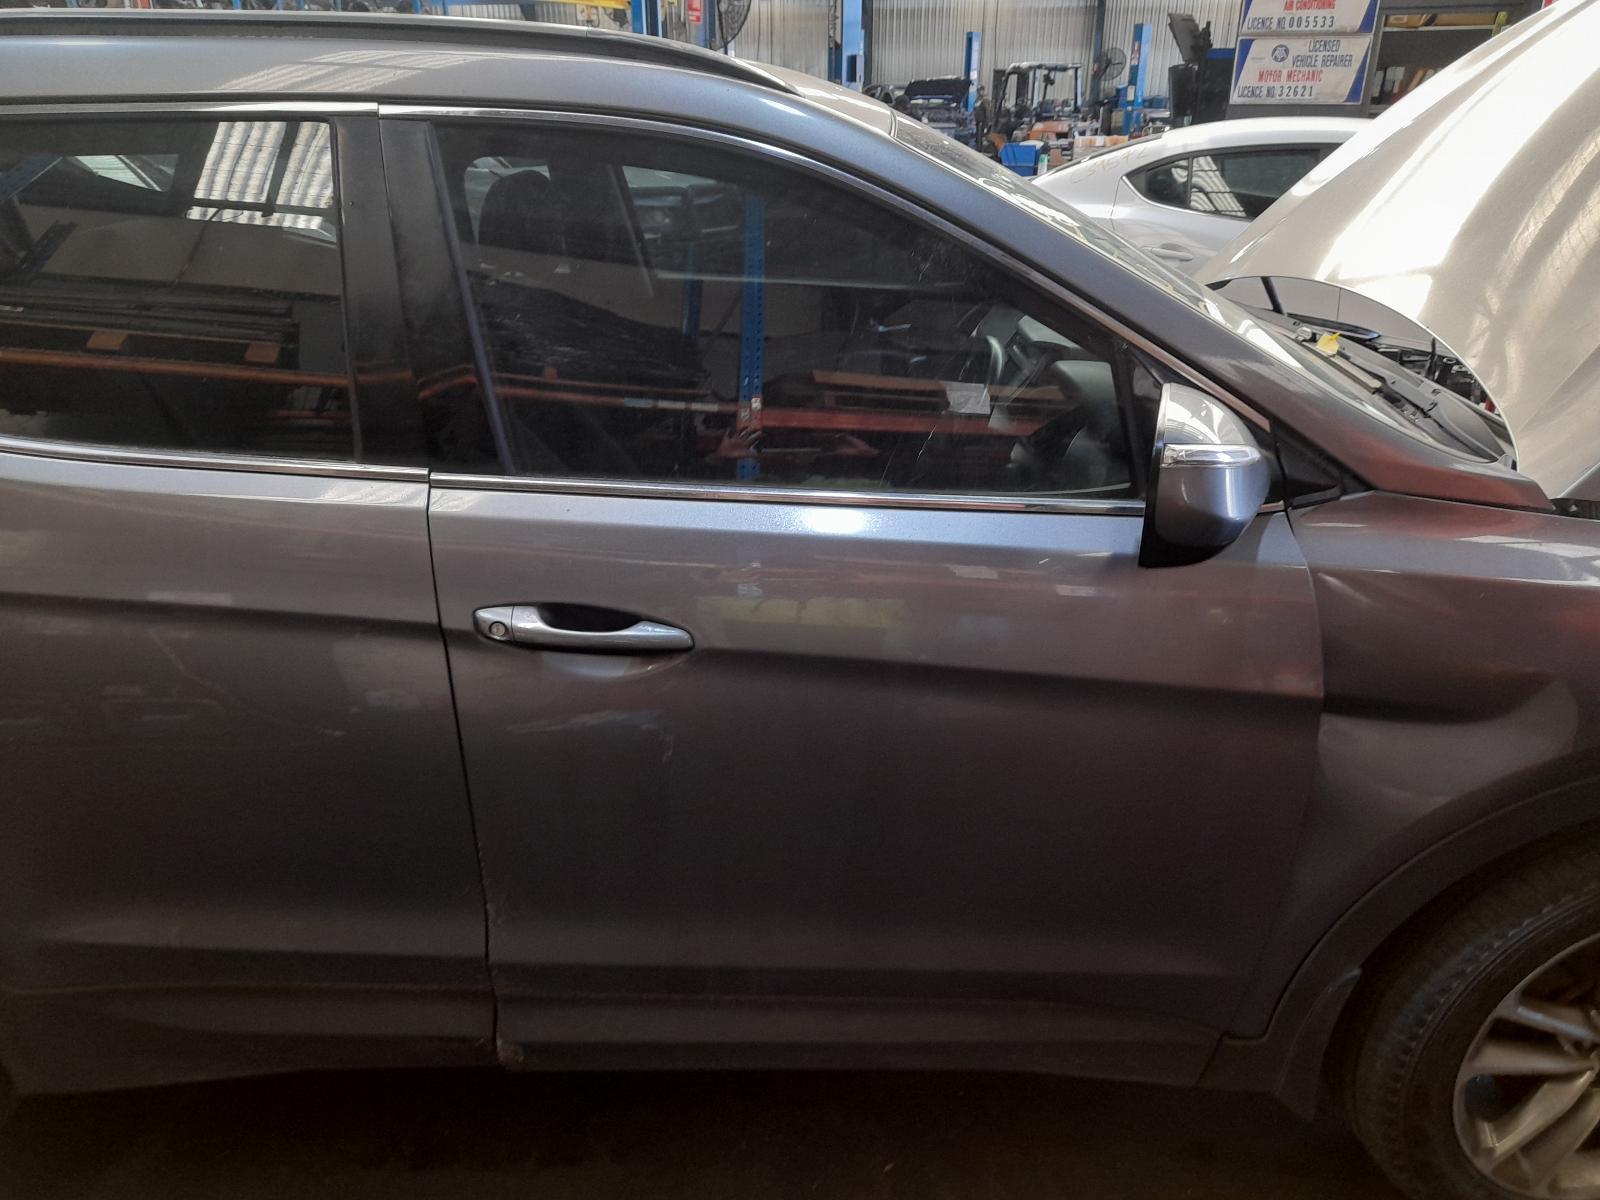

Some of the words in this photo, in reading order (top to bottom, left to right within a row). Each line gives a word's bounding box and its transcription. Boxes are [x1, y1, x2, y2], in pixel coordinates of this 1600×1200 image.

[1247, 17, 1274, 30] LICENCE
[1288, 15, 1335, 28] 005533
[1308, 39, 1341, 53] LICENSED
[1292, 55, 1319, 68] VEHICLE
[1320, 54, 1353, 67] REPAIRER
[1257, 69, 1283, 83] MOTOR
[1286, 69, 1324, 82] MECHANIC
[1237, 85, 1263, 98] LICENCE
[1278, 85, 1314, 97] 32621
